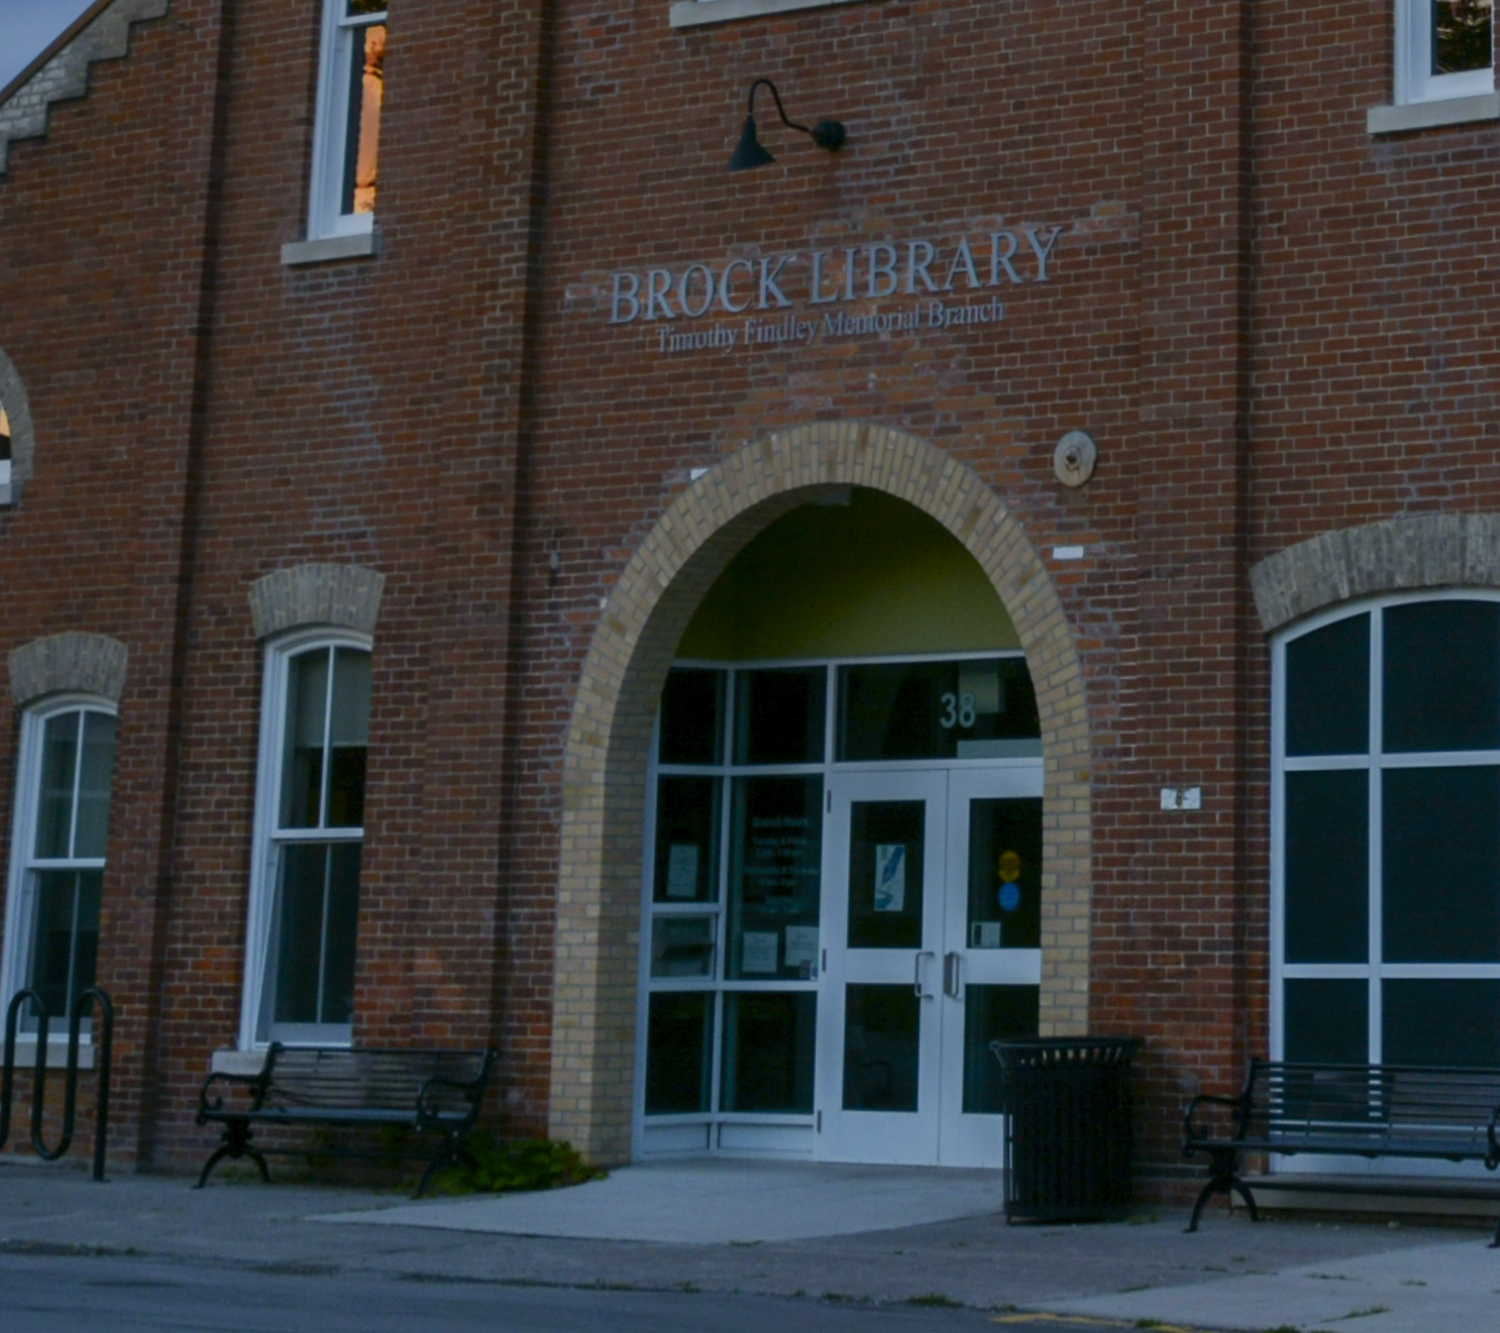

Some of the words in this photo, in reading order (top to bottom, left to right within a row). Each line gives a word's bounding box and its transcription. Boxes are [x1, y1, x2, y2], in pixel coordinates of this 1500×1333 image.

[607, 255, 797, 325] BROCK
[807, 224, 1064, 305] LIBRARY
[656, 322, 738, 354] Timothy
[744, 314, 820, 347] Findley
[822, 303, 922, 338] Memorial
[928, 295, 1007, 329] Branch
[940, 691, 977, 729] 38
